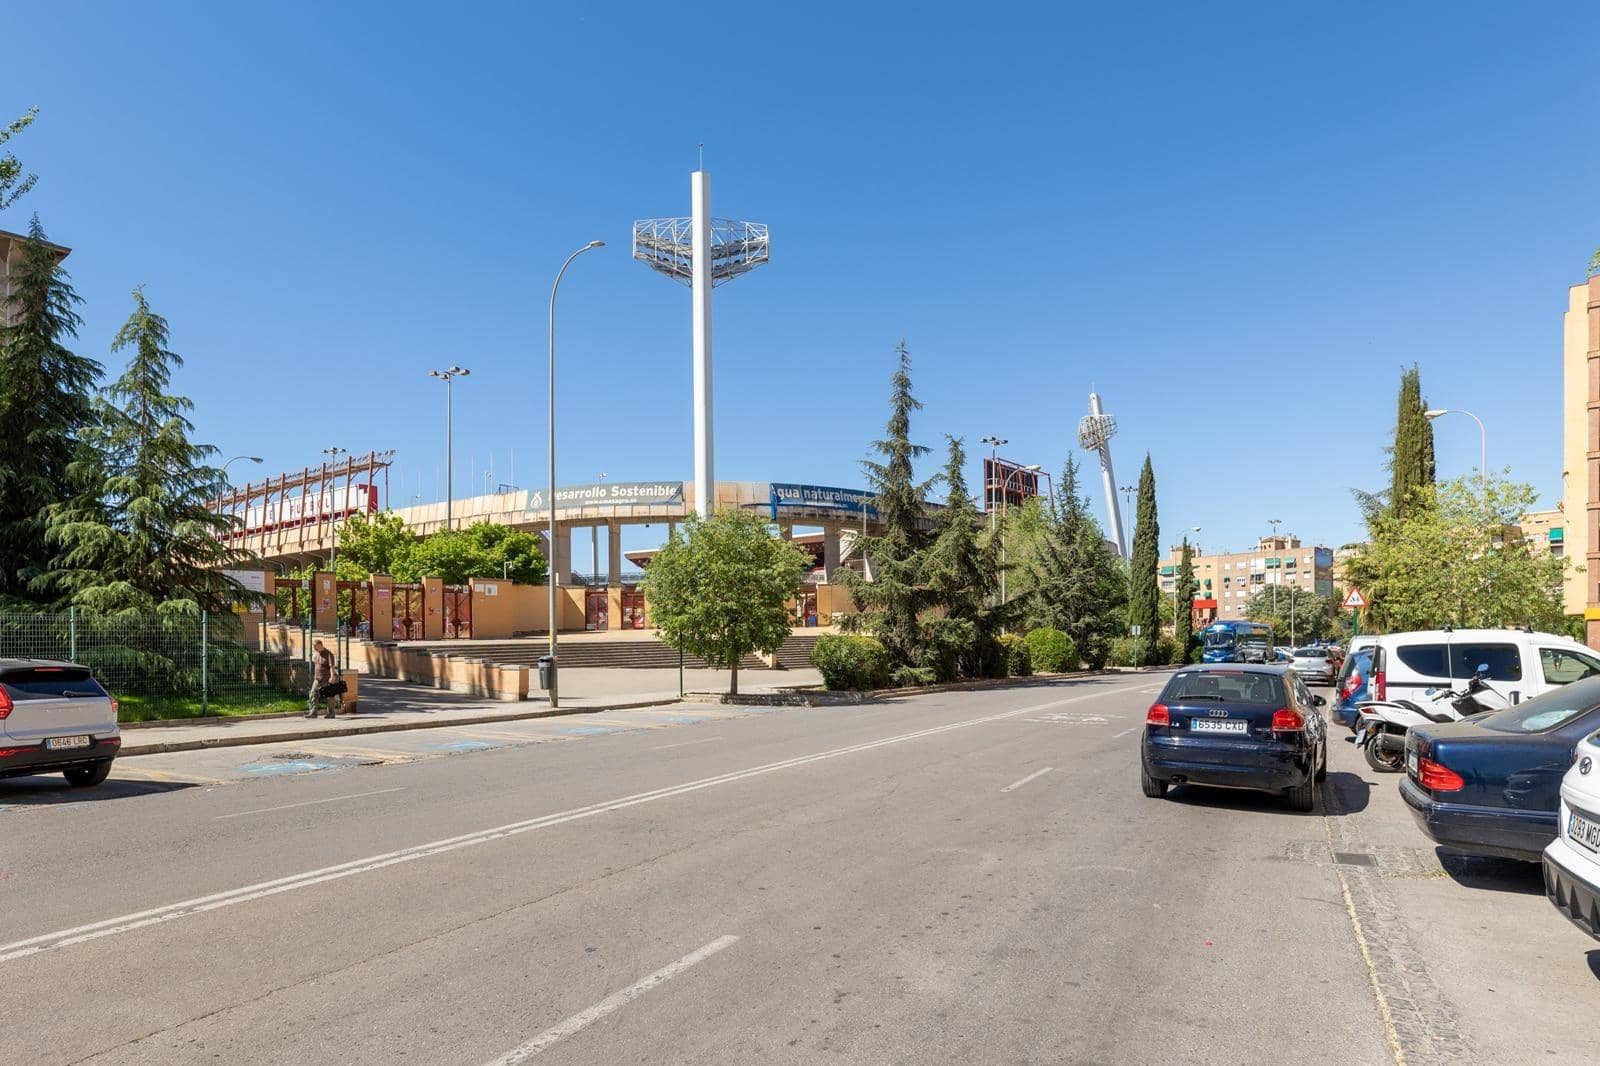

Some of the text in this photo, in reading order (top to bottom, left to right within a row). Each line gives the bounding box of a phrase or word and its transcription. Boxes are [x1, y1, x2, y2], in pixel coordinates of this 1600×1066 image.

[607, 483, 677, 497] Sostenible
[773, 485, 858, 503] gua naturalme
[1199, 719, 1243, 730] 6535 CXD
